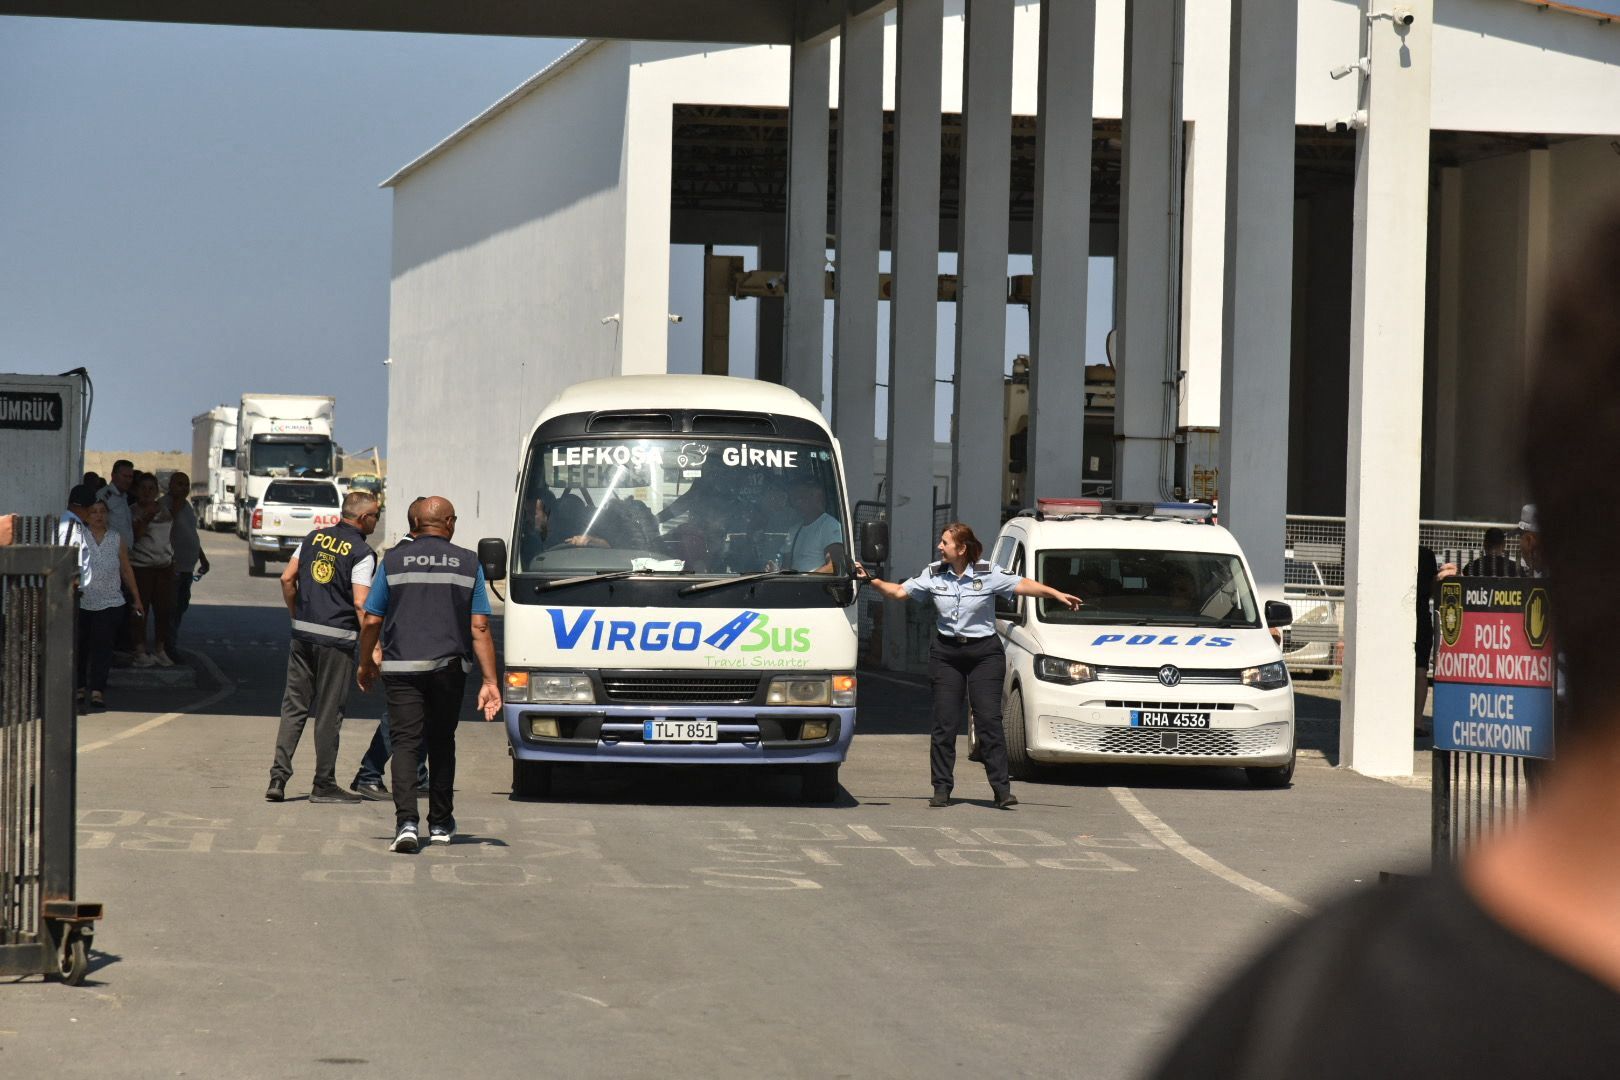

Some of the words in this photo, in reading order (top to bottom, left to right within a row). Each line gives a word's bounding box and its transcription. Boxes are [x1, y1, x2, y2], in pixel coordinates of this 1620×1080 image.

[0, 397, 54, 422] ÜMRÜK
[722, 443, 798, 468] GİRNE
[312, 533, 352, 556] POLİS
[403, 553, 460, 568] POLİS
[1475, 620, 1511, 650] POLİS
[704, 655, 748, 668] Travel
[751, 655, 810, 668] Smarter
[1437, 652, 1493, 679] KONTROL
[1469, 692, 1514, 720] POLICE
[655, 722, 684, 738] TLT
[687, 722, 713, 738] 851
[1143, 712, 1169, 727] RHA
[1173, 713, 1206, 727] 4536
[1452, 721, 1532, 751] CHECKPOINT
